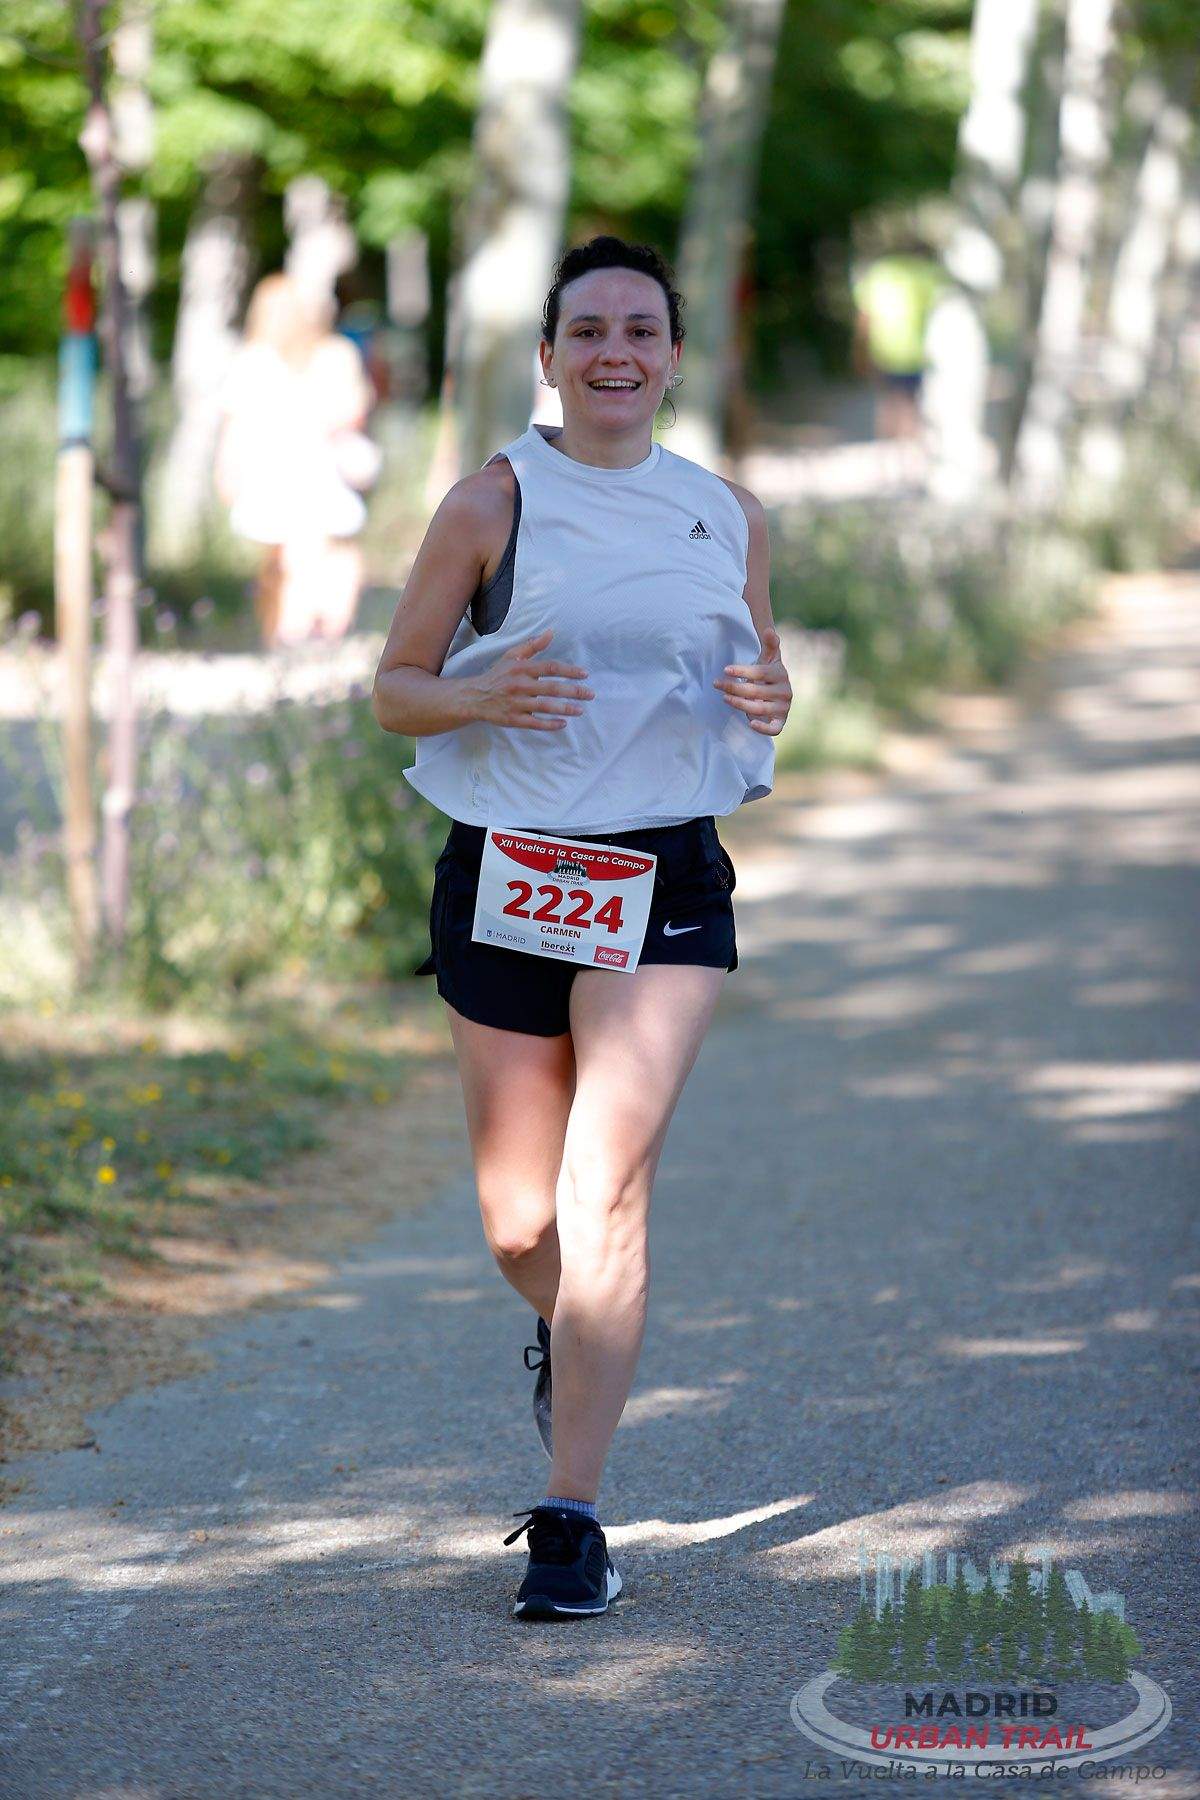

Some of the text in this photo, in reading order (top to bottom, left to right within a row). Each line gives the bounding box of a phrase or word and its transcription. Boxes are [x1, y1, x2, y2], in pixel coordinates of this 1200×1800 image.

[500, 839, 513, 848] XII
[515, 841, 546, 854] Vuelta
[557, 848, 567, 857] la
[571, 851, 595, 861] Casa
[597, 854, 609, 863] de
[612, 857, 645, 870] Campo
[503, 880, 624, 934] 2224
[496, 932, 526, 944] MADRID
[540, 925, 581, 939] CARMEN
[541, 941, 576, 953] Iberext
